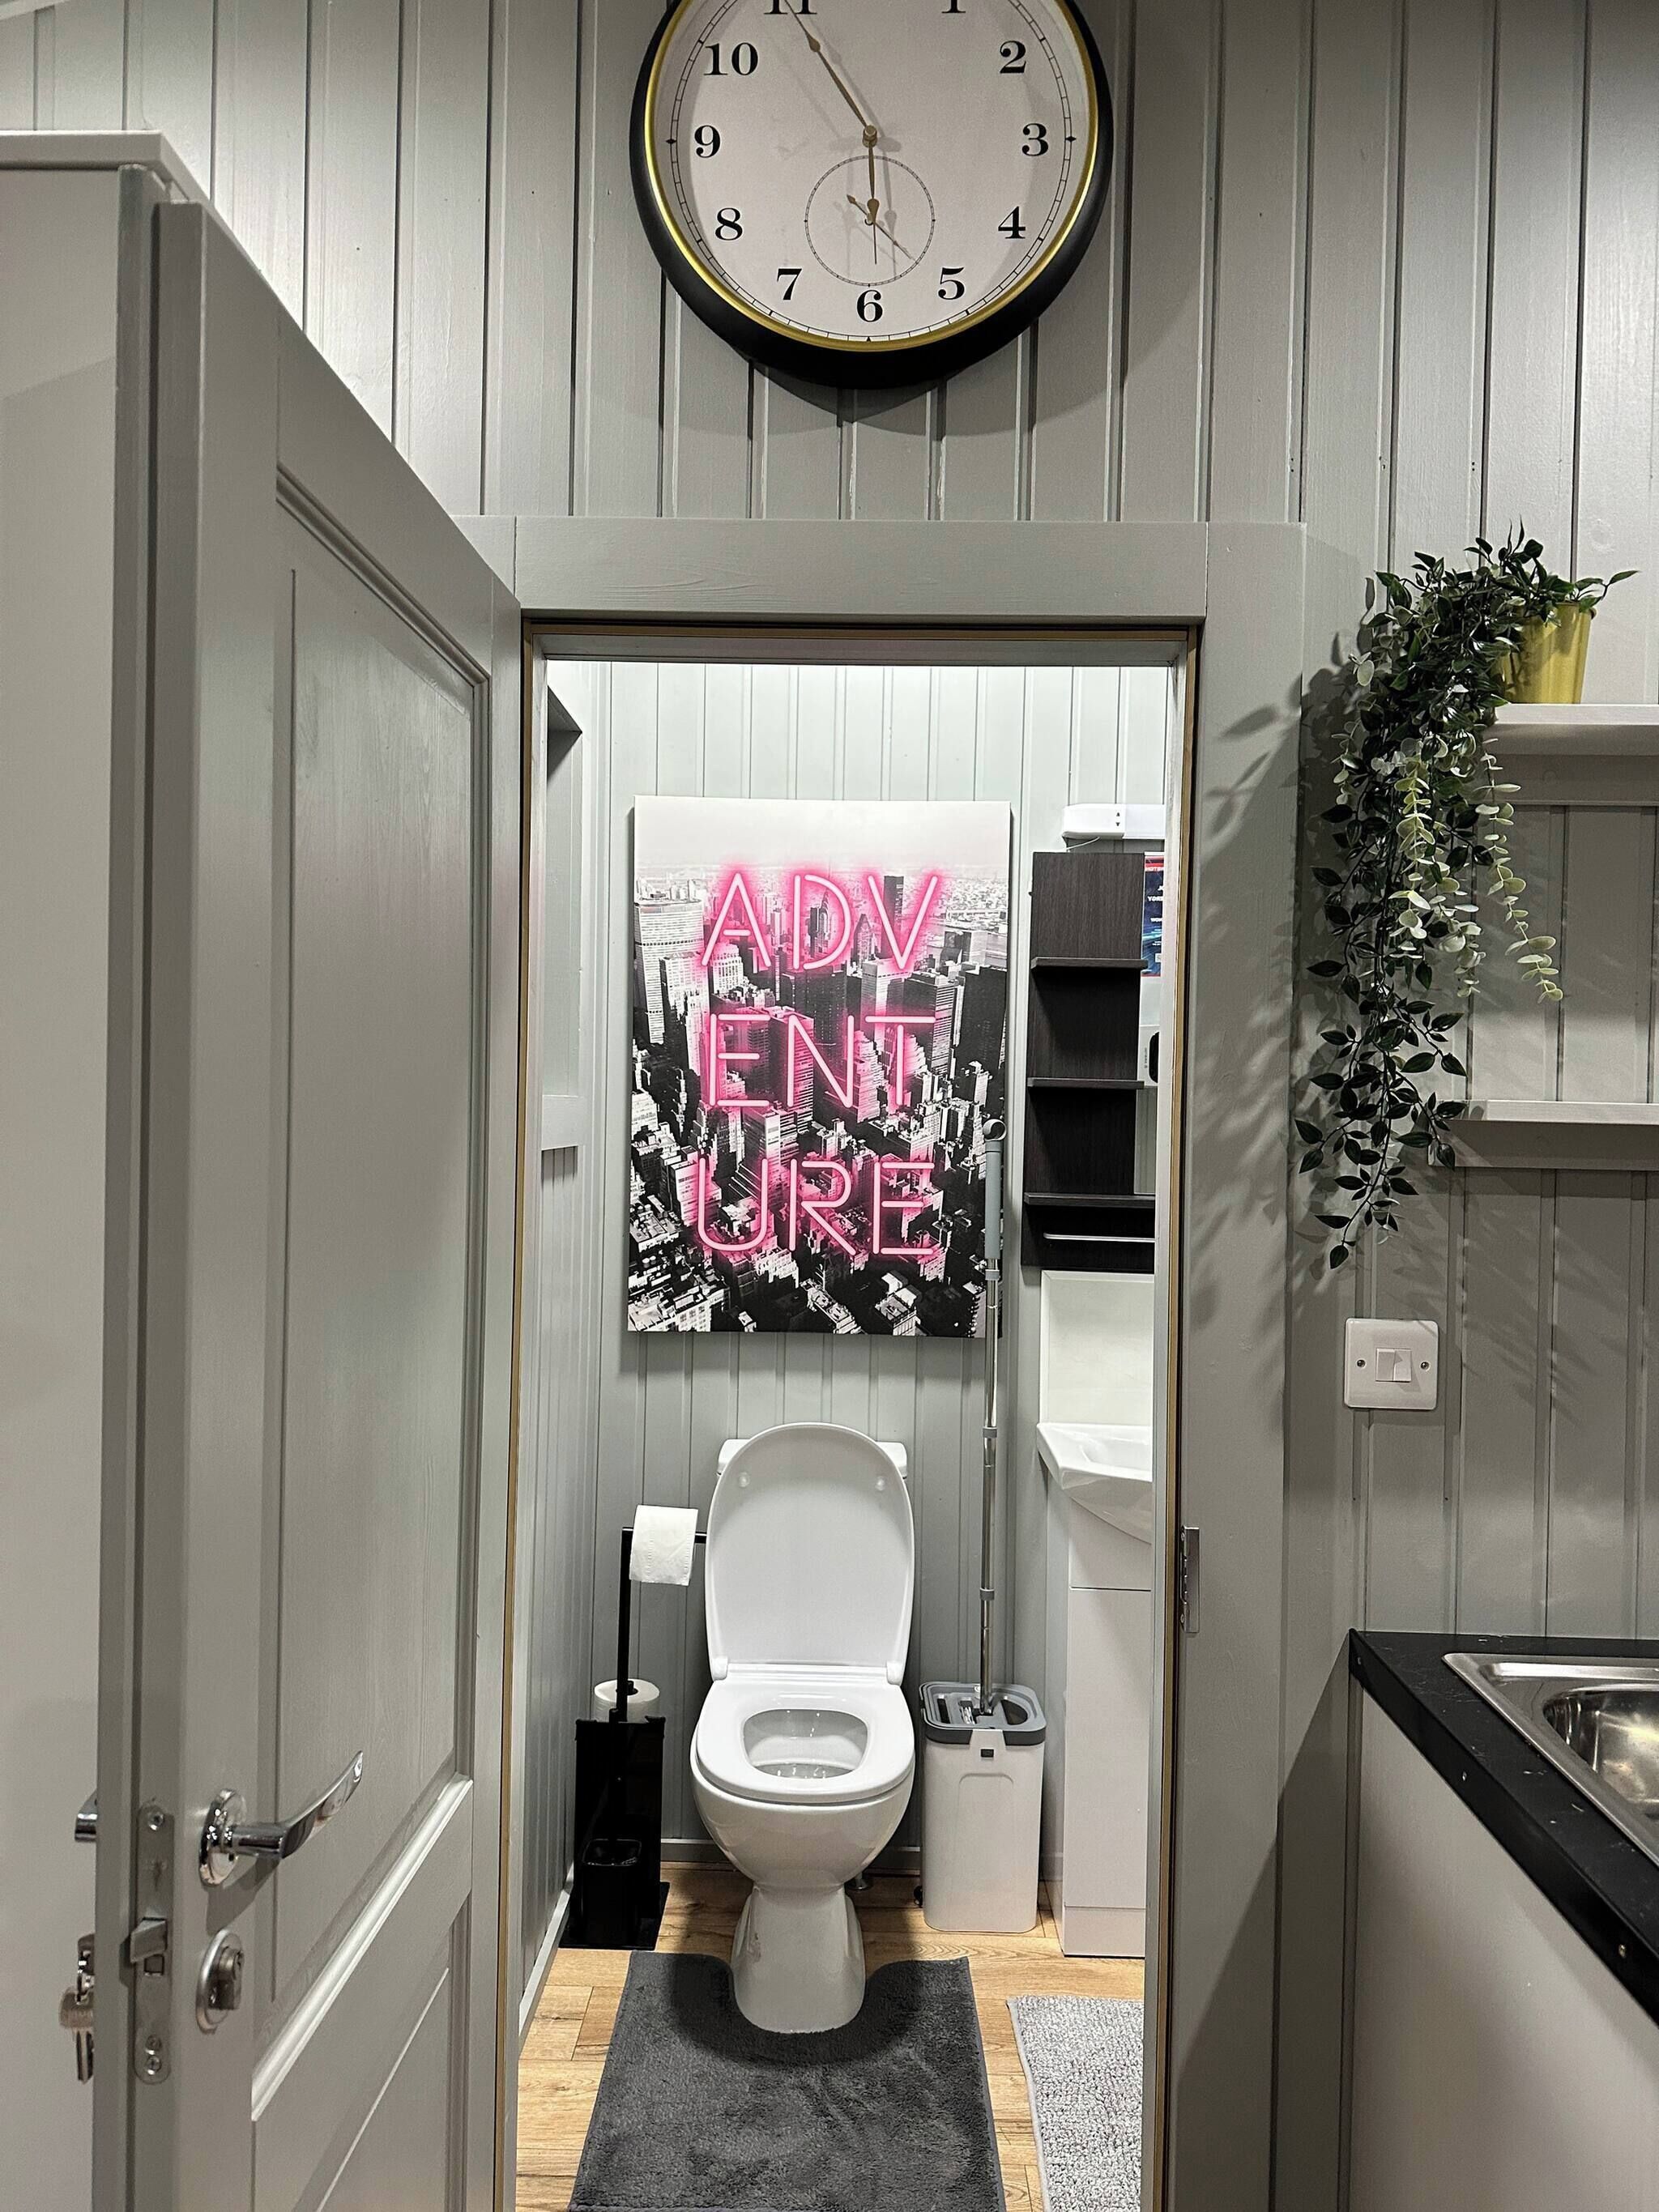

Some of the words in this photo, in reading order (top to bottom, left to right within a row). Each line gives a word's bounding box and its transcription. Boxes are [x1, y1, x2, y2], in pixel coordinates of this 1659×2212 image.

[704, 42, 758, 75] 10
[1000, 40, 1027, 74] 2
[694, 126, 721, 158] 9
[1021, 123, 1048, 156] 3
[715, 207, 743, 241] 8
[998, 207, 1026, 239] 4
[776, 268, 802, 300] 7
[938, 267, 966, 300] 5
[856, 289, 883, 322] 6
[702, 872, 938, 970] ADV
[710, 1014, 936, 1108] ENT
[698, 1157, 935, 1256] URE
